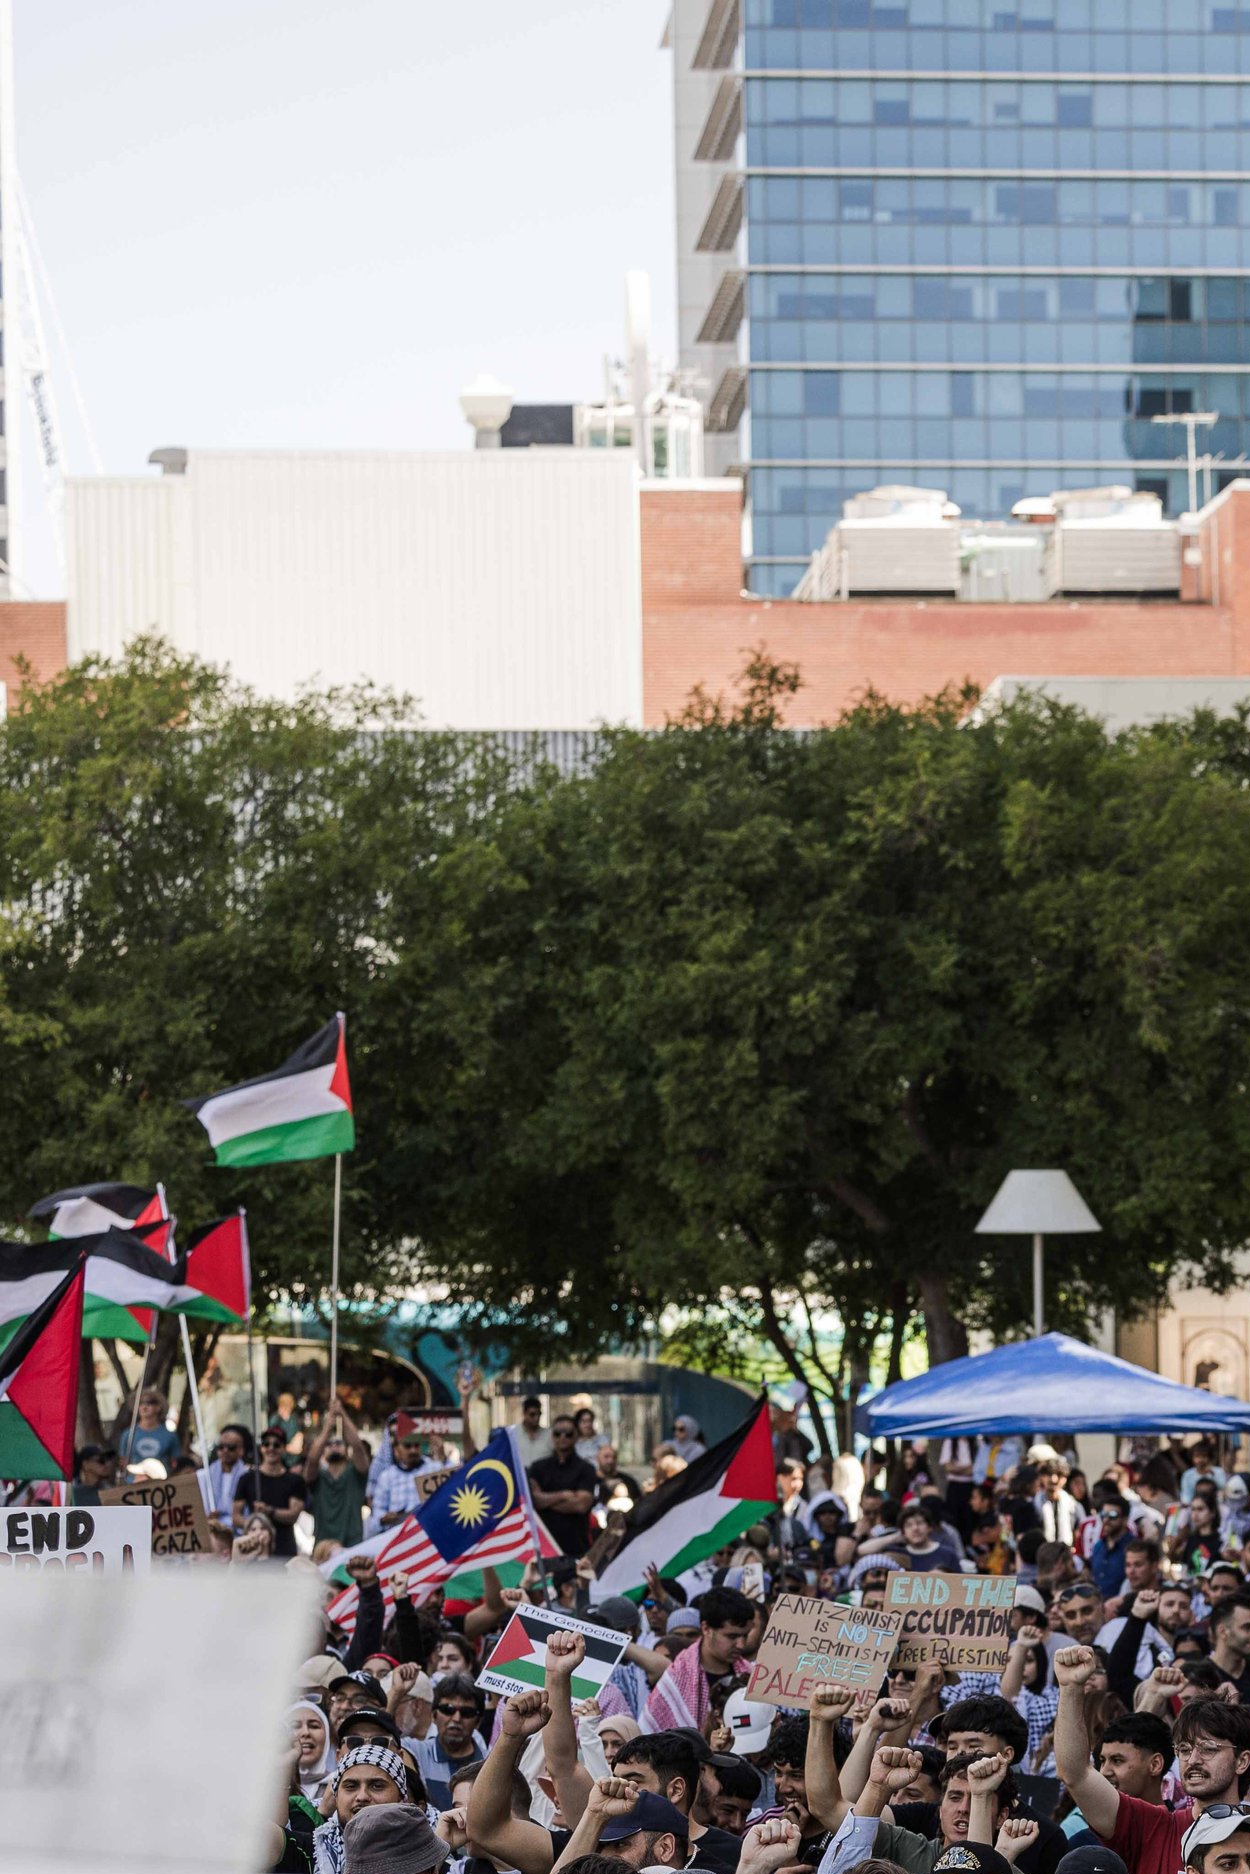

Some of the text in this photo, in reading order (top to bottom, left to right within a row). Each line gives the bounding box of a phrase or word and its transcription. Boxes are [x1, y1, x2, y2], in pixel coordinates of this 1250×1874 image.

[7, 1509, 95, 1555] END
[154, 1530, 202, 1556] GAZA
[890, 1577, 1016, 1607] END THE
[523, 1606, 624, 1643] The Genocide
[775, 1594, 902, 1631] ANTI-ZIONISM
[891, 1606, 1012, 1637] CCUPATION
[763, 1626, 890, 1664] ANTI-SEMITISM
[815, 1619, 894, 1647] IS NOT
[796, 1652, 873, 1683] FREE
[484, 1675, 524, 1694] must stop
[748, 1664, 879, 1706] PALENE
